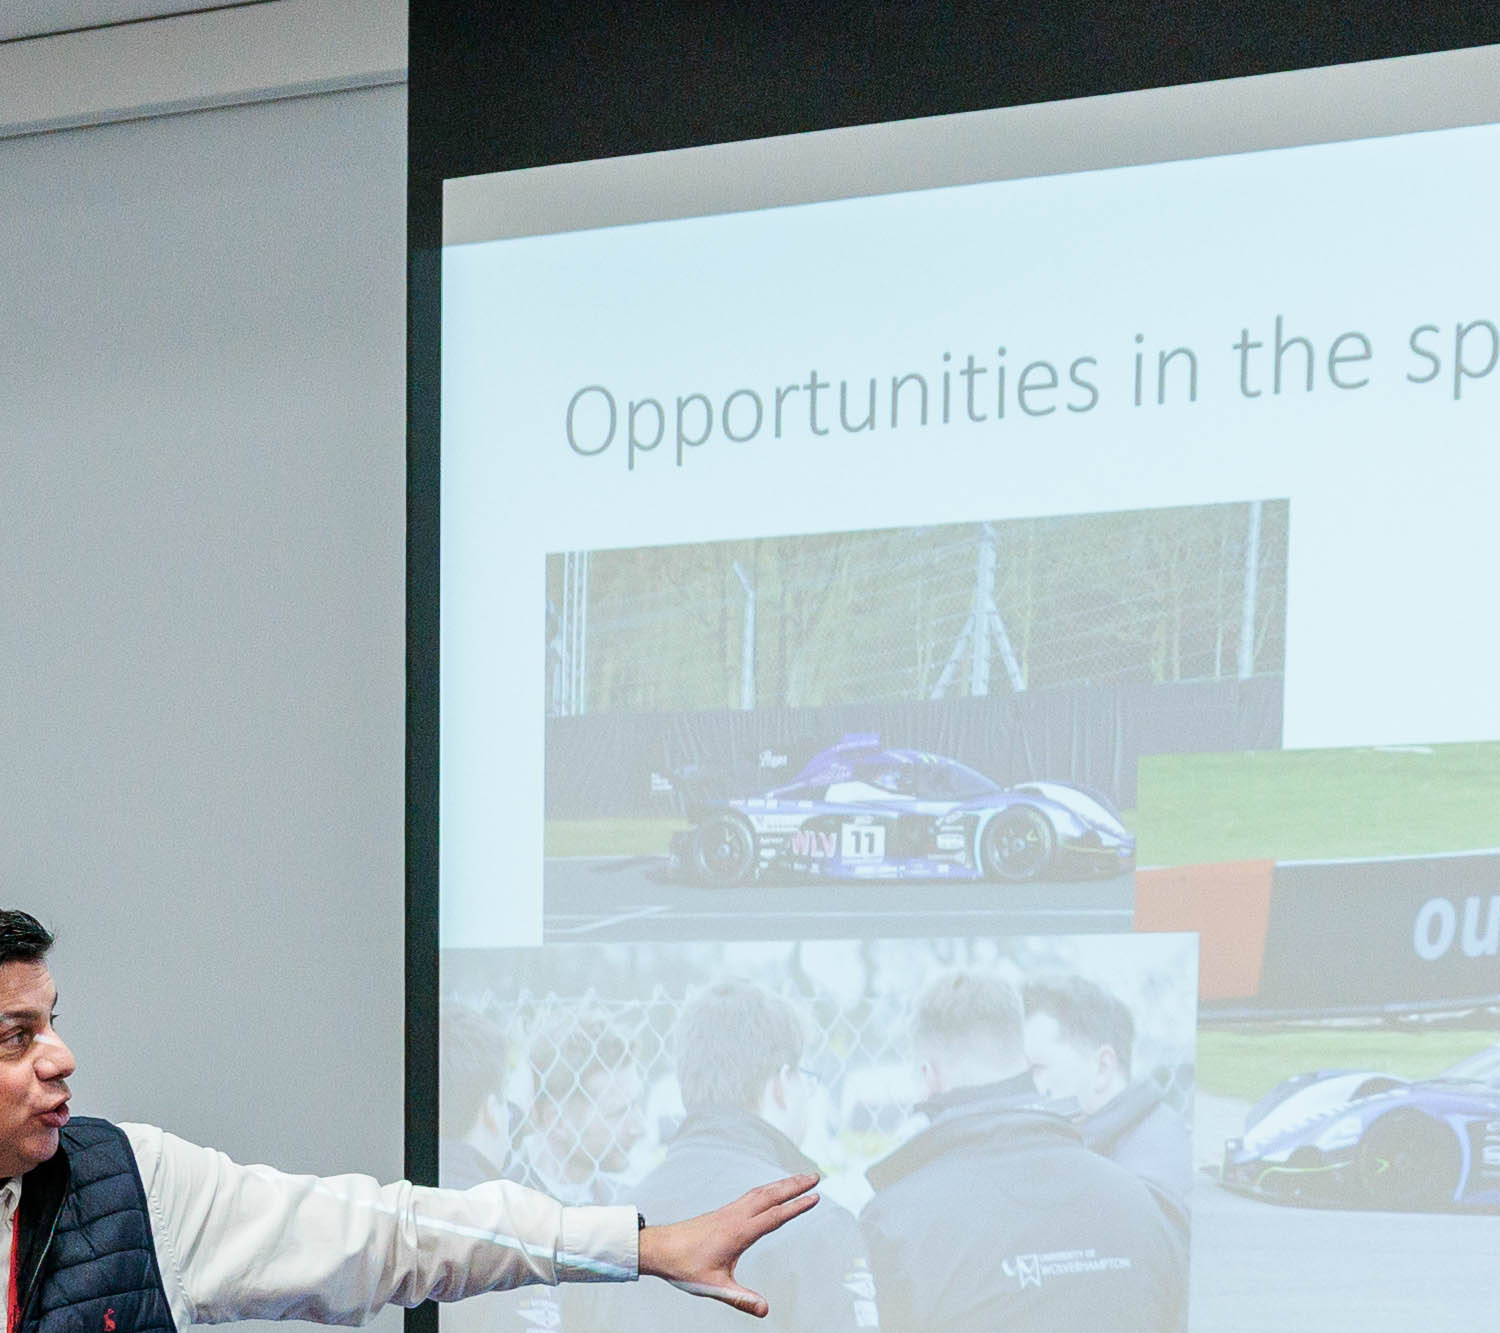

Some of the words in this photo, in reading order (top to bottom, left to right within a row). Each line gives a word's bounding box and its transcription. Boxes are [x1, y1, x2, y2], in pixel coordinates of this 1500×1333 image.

[566, 346, 1099, 471] Opportunities
[1134, 333, 1197, 406] in
[1232, 314, 1372, 398] the
[851, 830, 876, 856] 11
